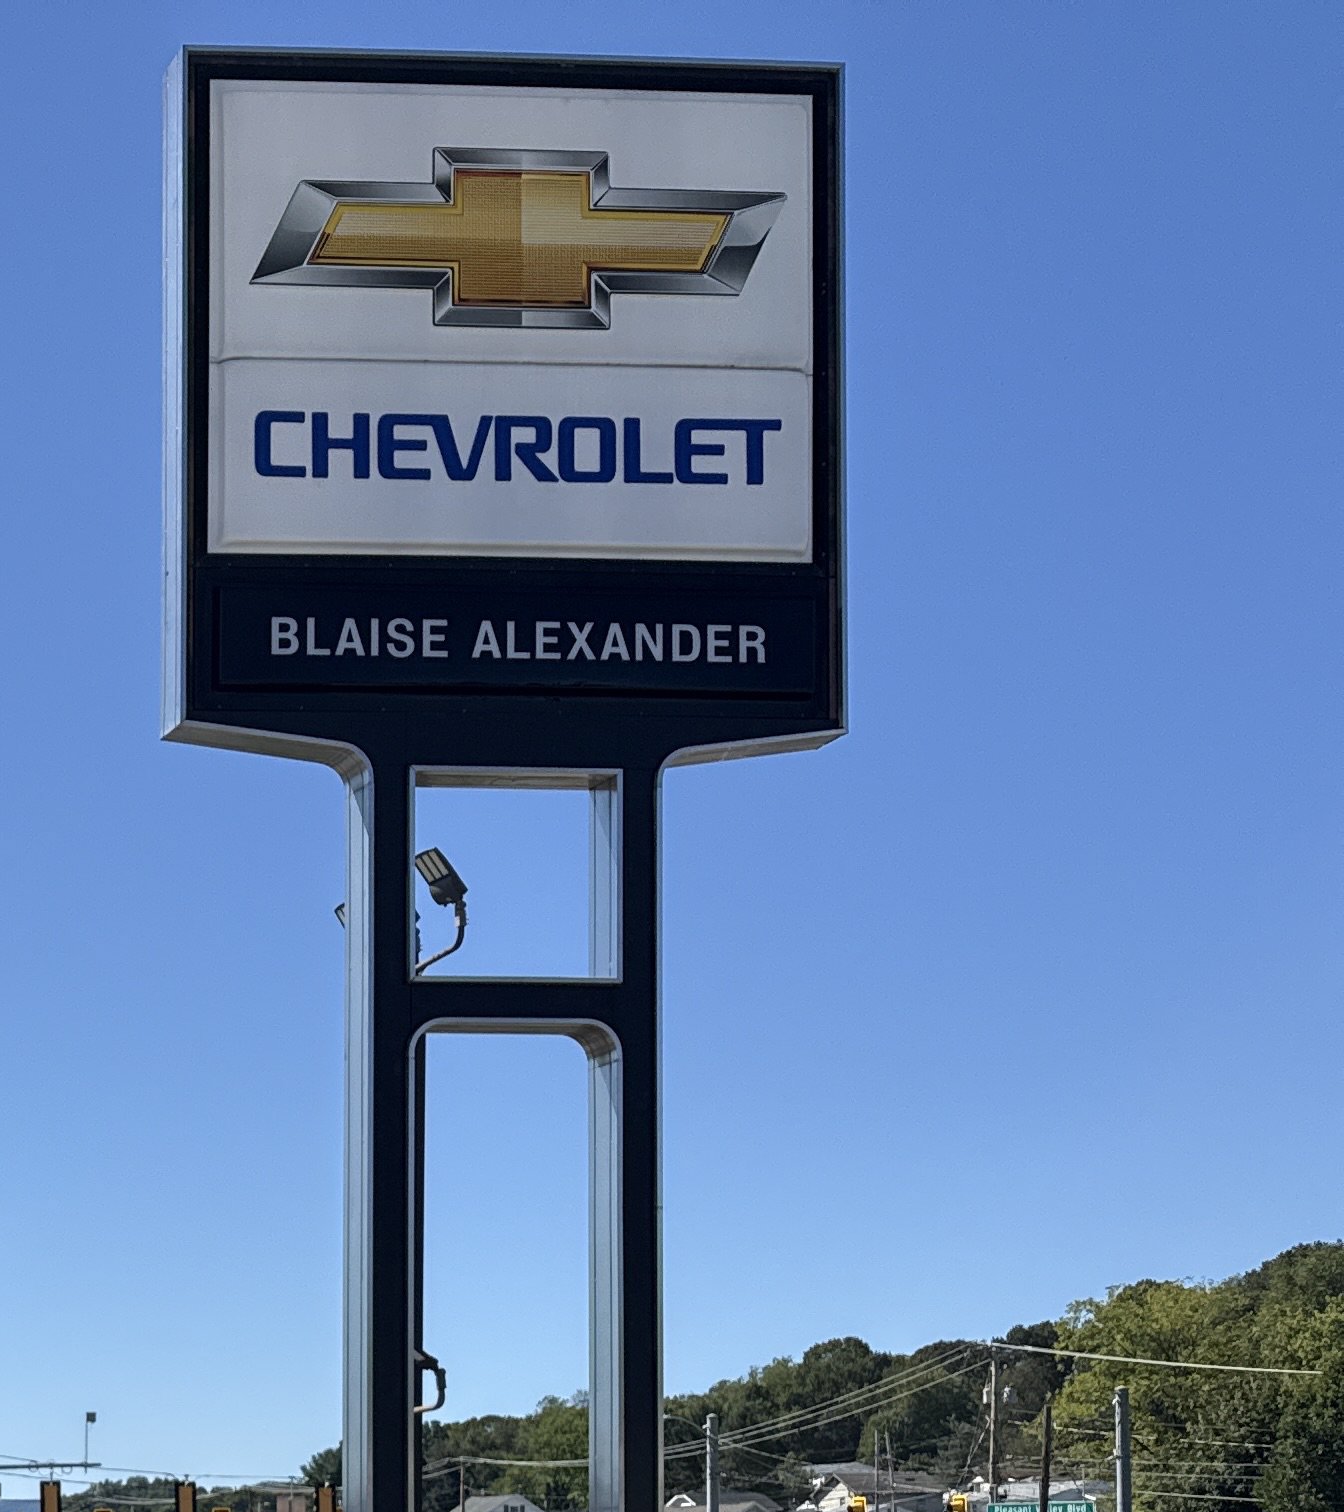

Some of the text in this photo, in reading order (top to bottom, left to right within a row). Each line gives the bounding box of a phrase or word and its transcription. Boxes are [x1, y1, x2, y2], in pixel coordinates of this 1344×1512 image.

[253, 409, 782, 486] CHEVROLET
[269, 616, 767, 664] BLAISE ALEXANDER
